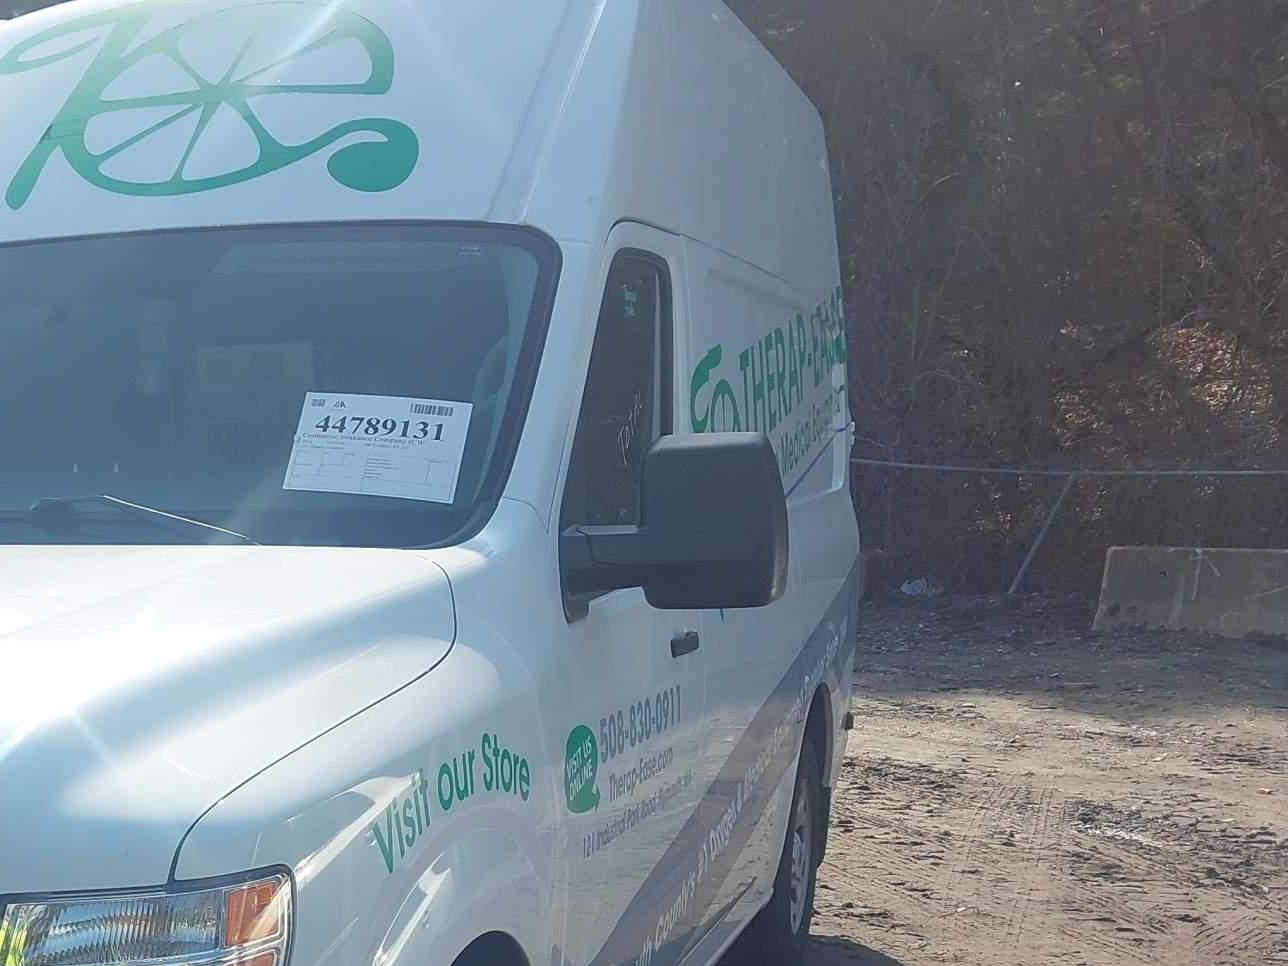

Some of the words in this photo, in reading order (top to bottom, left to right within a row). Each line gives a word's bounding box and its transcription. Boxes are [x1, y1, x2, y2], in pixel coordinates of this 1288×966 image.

[314, 415, 444, 441] 44789131
[599, 684, 682, 764] 508-830-0911
[566, 746, 582, 780] VISIT
[582, 735, 592, 759] US
[569, 758, 593, 801] ONLINE
[608, 747, 673, 803] Therap-Ease.com
[370, 767, 431, 875] Visit
[437, 747, 476, 811] our
[481, 732, 531, 802] Store
[583, 832, 595, 860] 121
